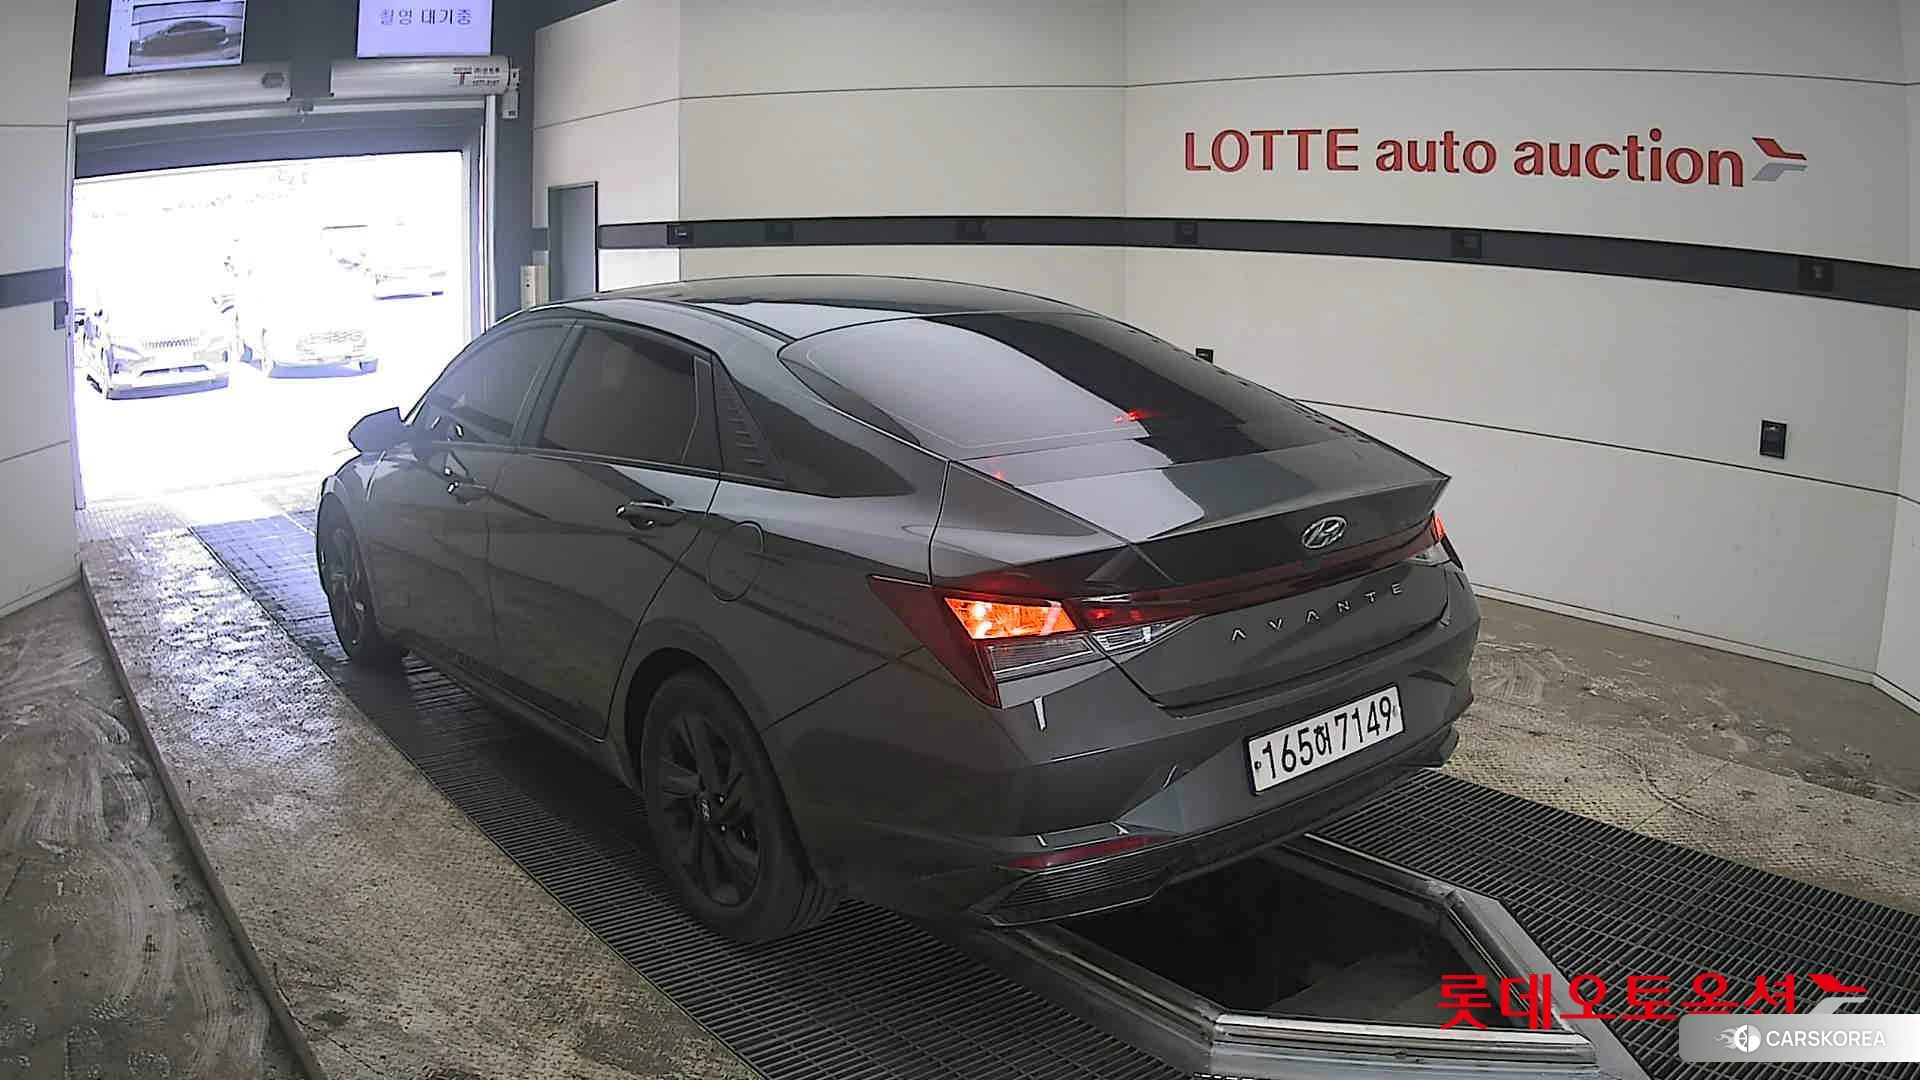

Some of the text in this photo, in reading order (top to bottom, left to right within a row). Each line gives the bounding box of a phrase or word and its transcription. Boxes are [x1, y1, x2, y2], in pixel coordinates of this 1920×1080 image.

[421, 8, 472, 26] 대기중
[1184, 127, 1744, 187] LOTTE auto auction
[1231, 583, 1403, 641] AVANTE
[1262, 695, 1393, 779] 165허7149
